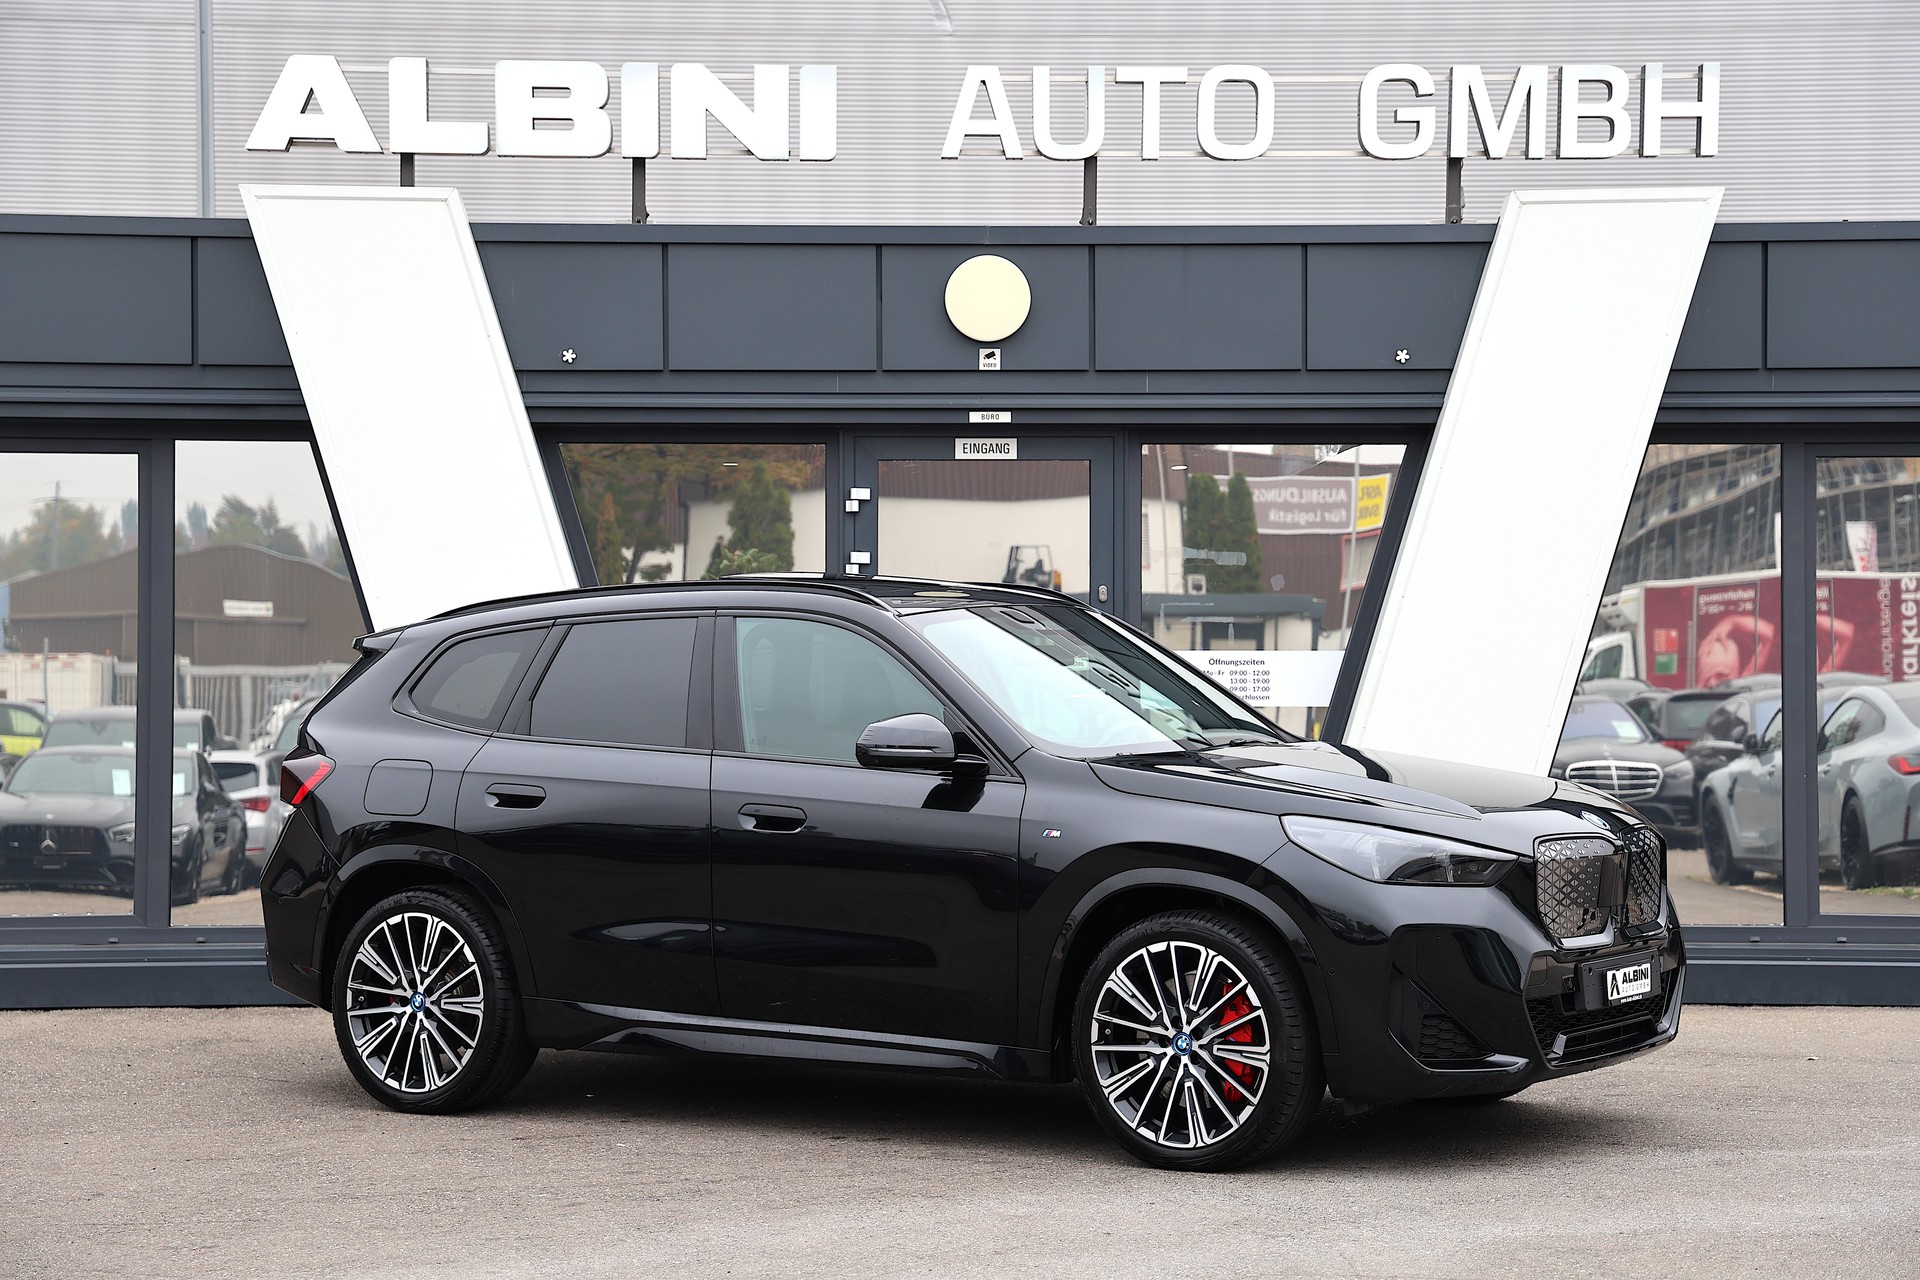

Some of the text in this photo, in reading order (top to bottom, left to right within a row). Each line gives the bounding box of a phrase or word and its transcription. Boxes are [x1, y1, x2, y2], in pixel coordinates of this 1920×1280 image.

[246, 54, 1722, 162] ALBINI AUTO GMBH
[963, 443, 1010, 454] EINGANG
[1208, 657, 1265, 666] Öffnungszeiten
[1622, 967, 1648, 984] ALBINI
